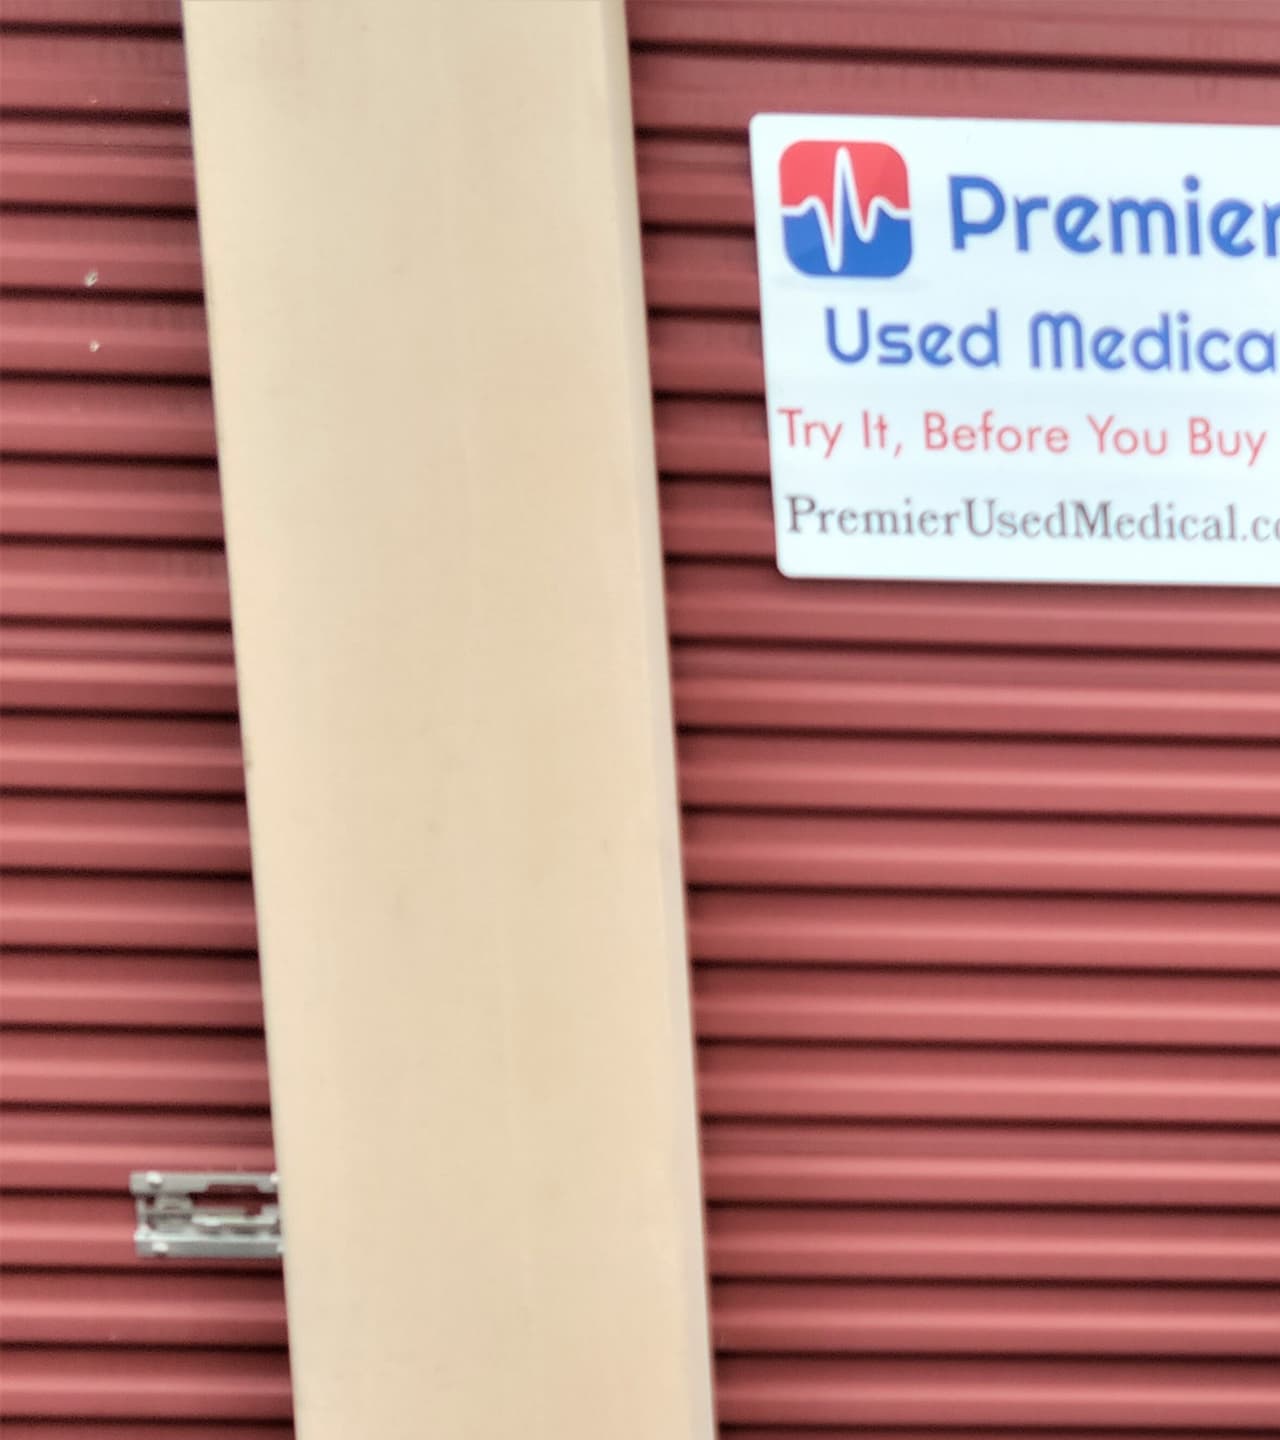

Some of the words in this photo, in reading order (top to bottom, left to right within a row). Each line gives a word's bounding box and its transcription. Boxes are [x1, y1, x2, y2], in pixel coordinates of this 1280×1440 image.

[825, 307, 1000, 368] Used
[778, 408, 842, 458] Try
[863, 411, 901, 456] It,
[924, 411, 1068, 453] Before
[1088, 416, 1166, 455] You
[1189, 417, 1266, 466] Buy
